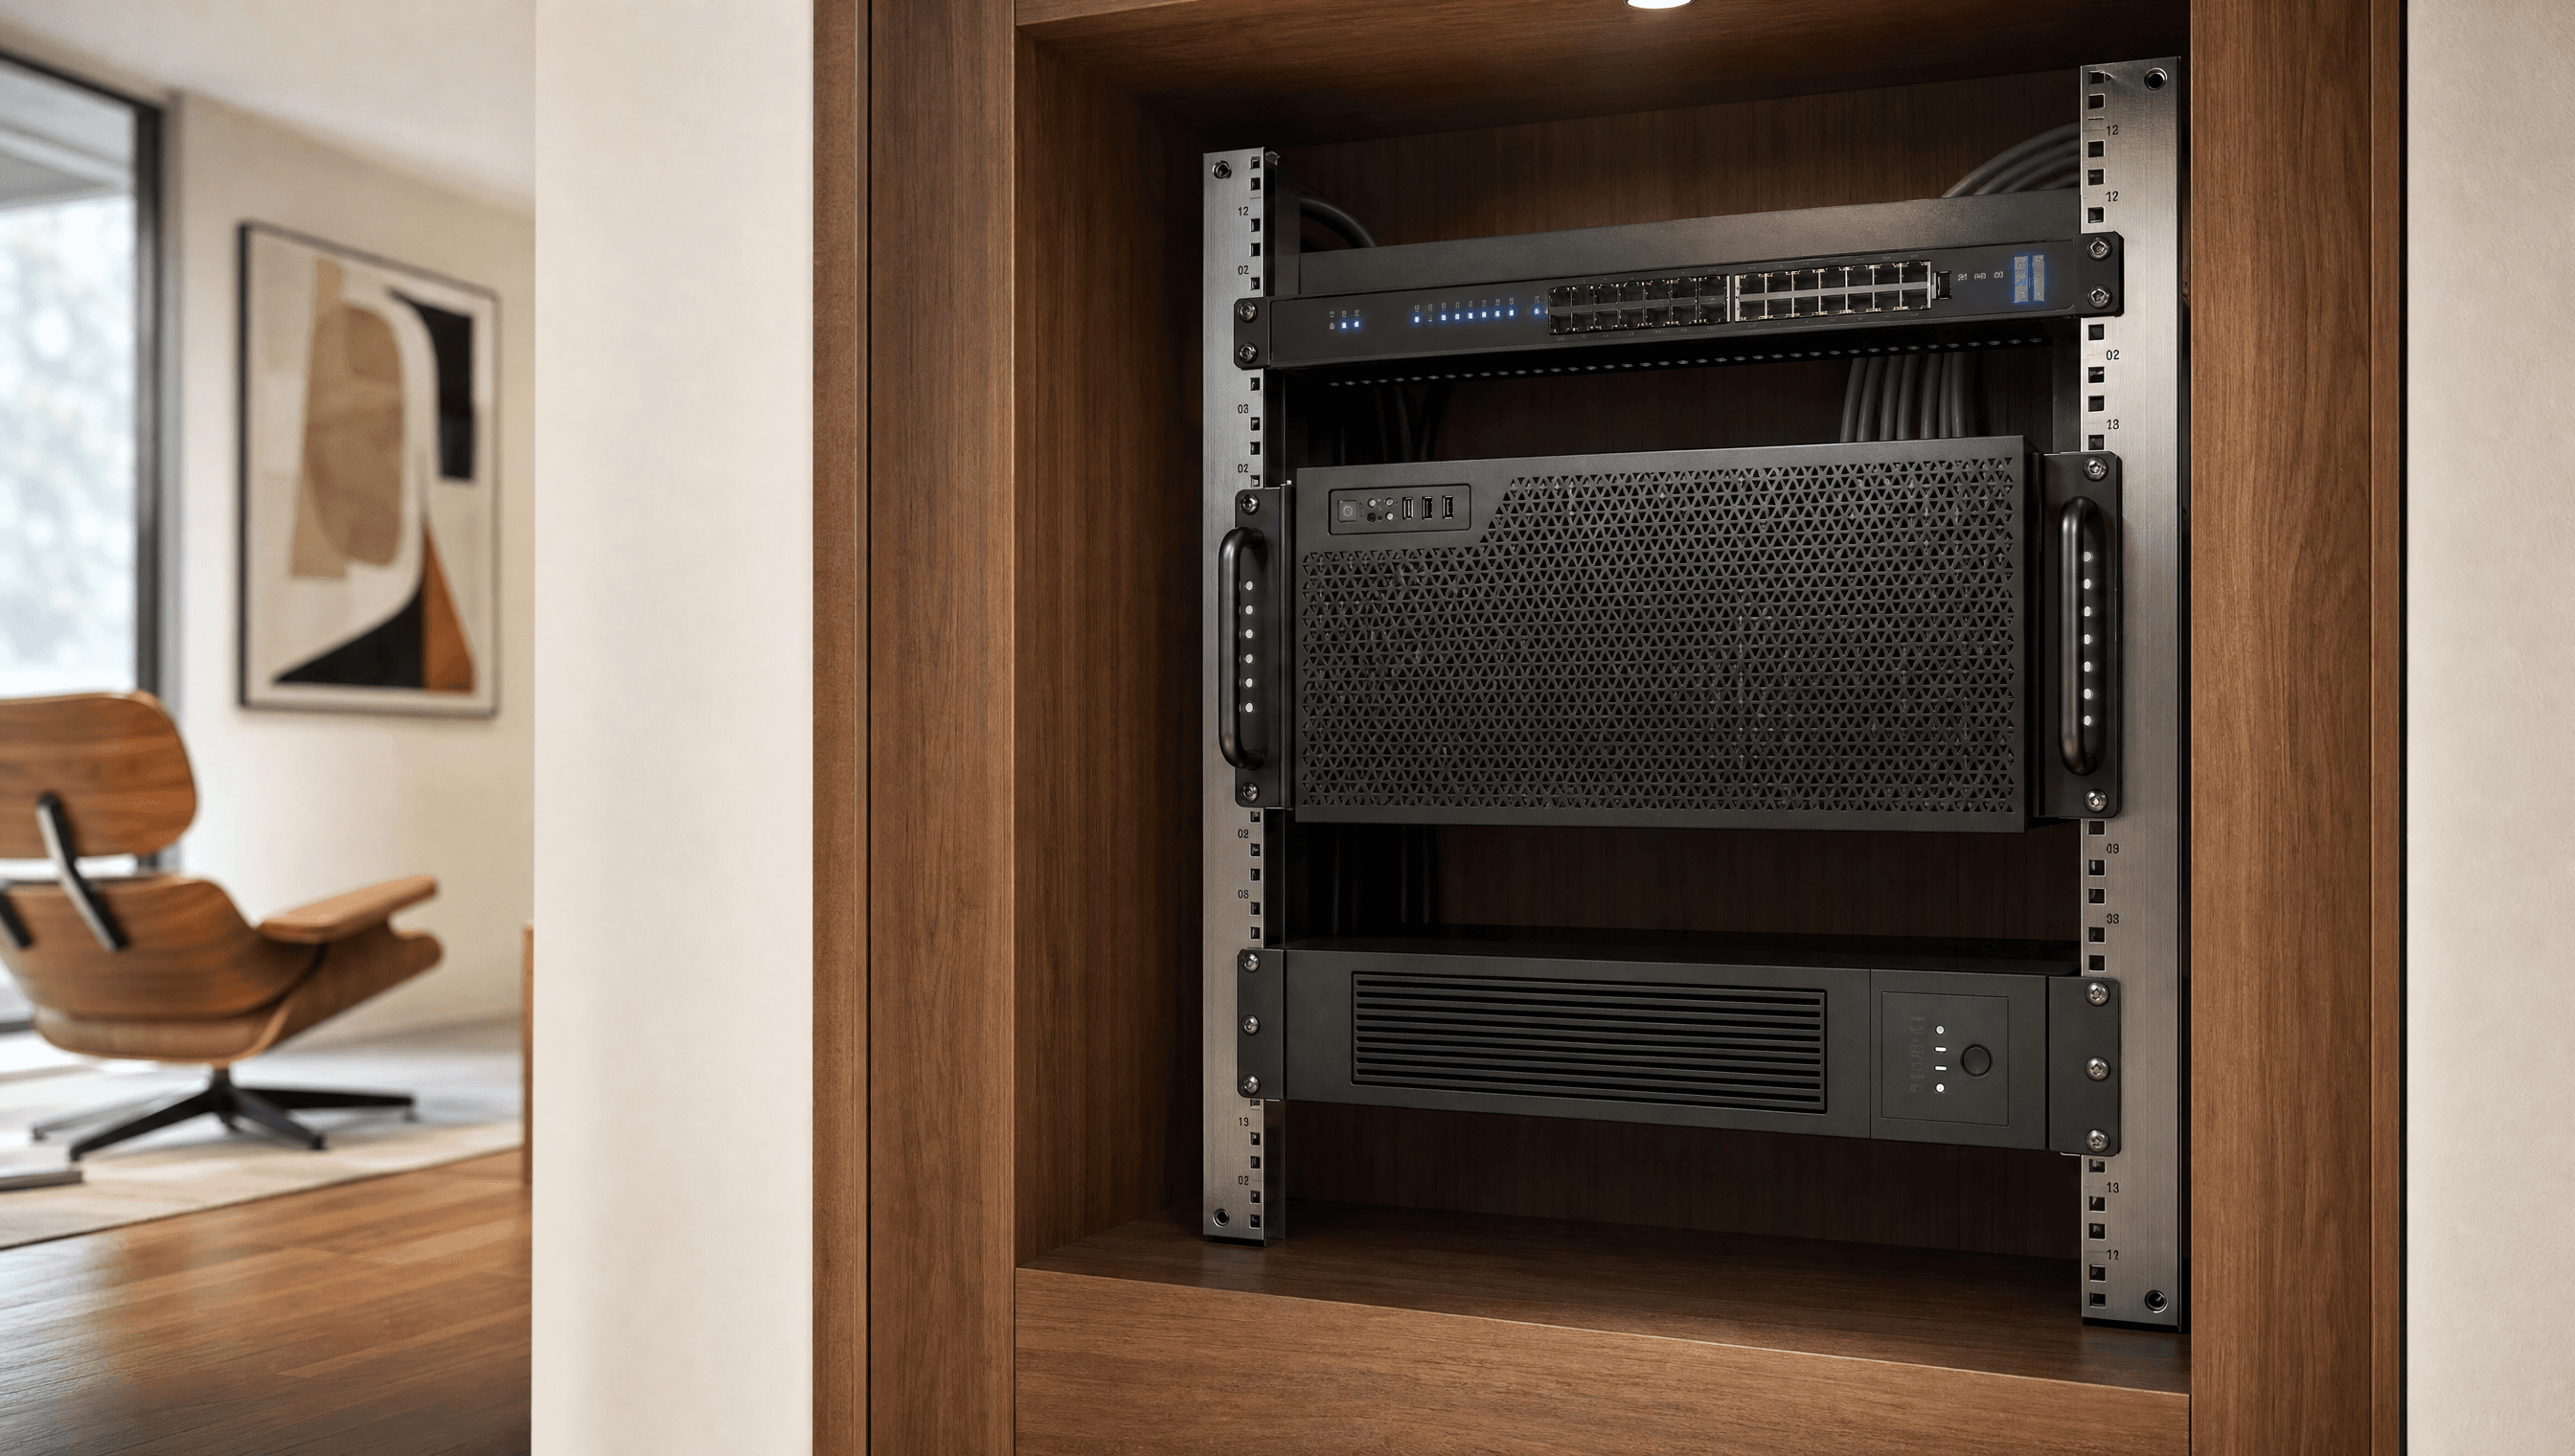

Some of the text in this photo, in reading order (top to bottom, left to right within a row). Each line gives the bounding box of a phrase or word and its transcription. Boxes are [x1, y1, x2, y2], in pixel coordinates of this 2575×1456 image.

[2106, 191, 2119, 202] 12
[1238, 206, 1249, 216] 12
[1238, 264, 1249, 276] 02
[2106, 349, 2120, 361] 02
[1237, 464, 1249, 474] 02
[1237, 1174, 1249, 1186] 02
[2106, 1248, 2120, 1261] 12
